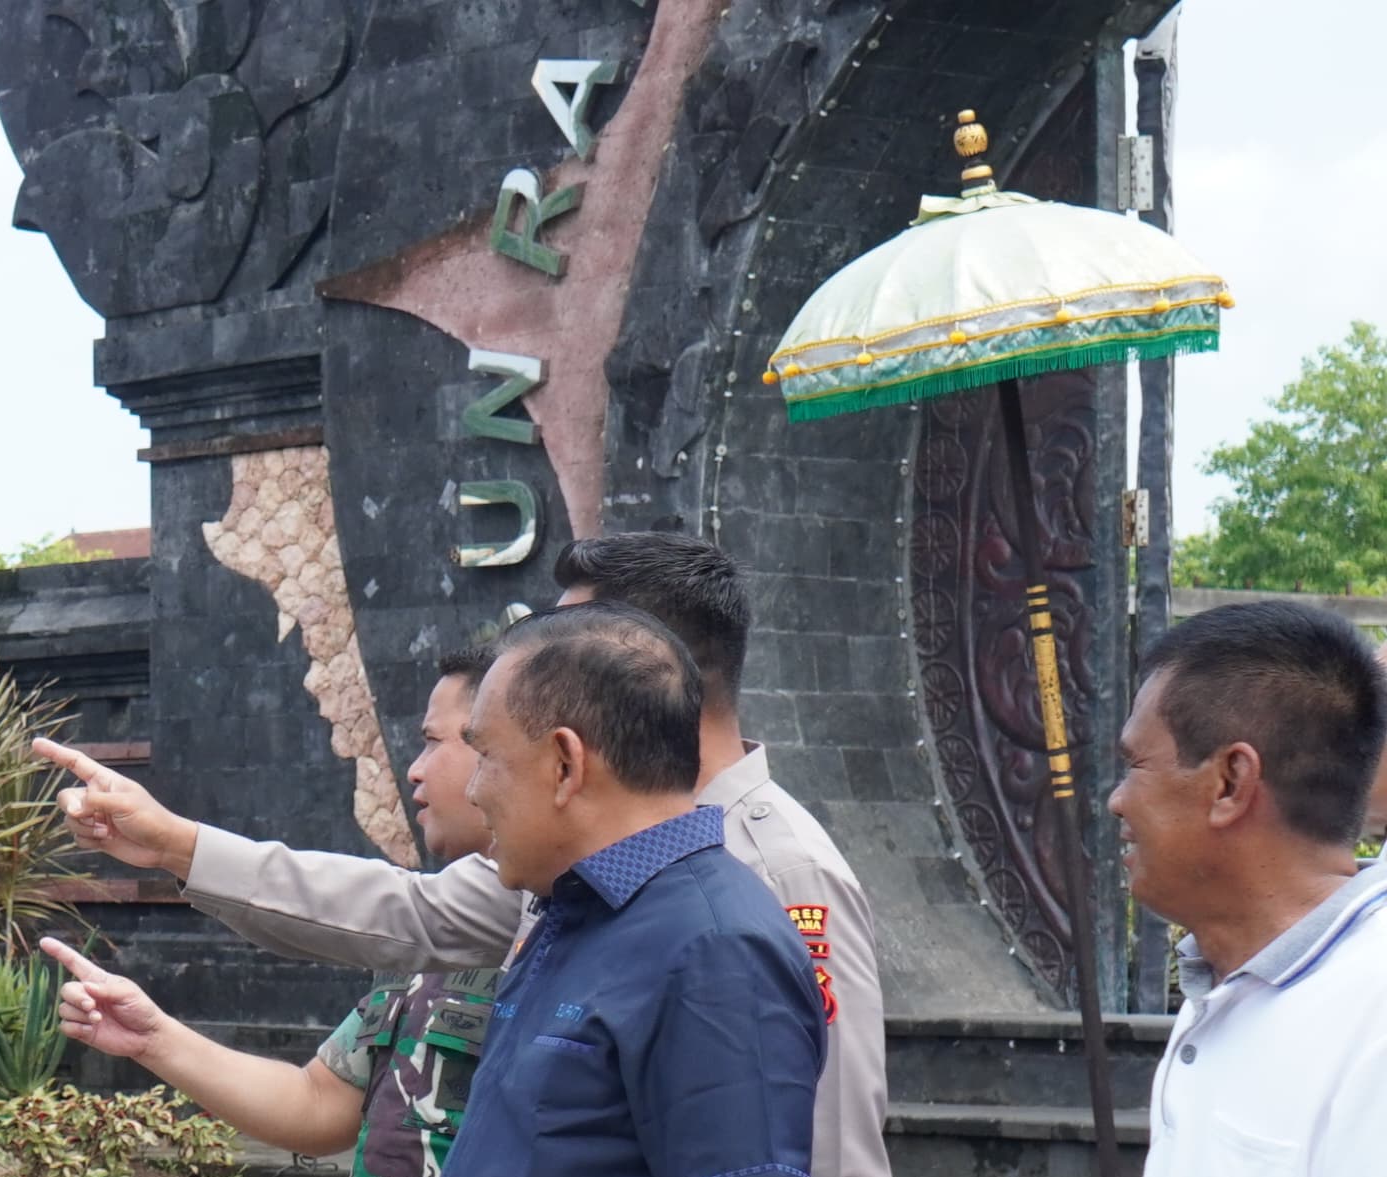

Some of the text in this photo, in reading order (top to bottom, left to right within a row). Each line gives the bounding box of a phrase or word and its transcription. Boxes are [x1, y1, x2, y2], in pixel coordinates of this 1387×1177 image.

[789, 908, 824, 921] RES
[797, 919, 822, 931] ANA
[451, 969, 498, 993] TNI A
